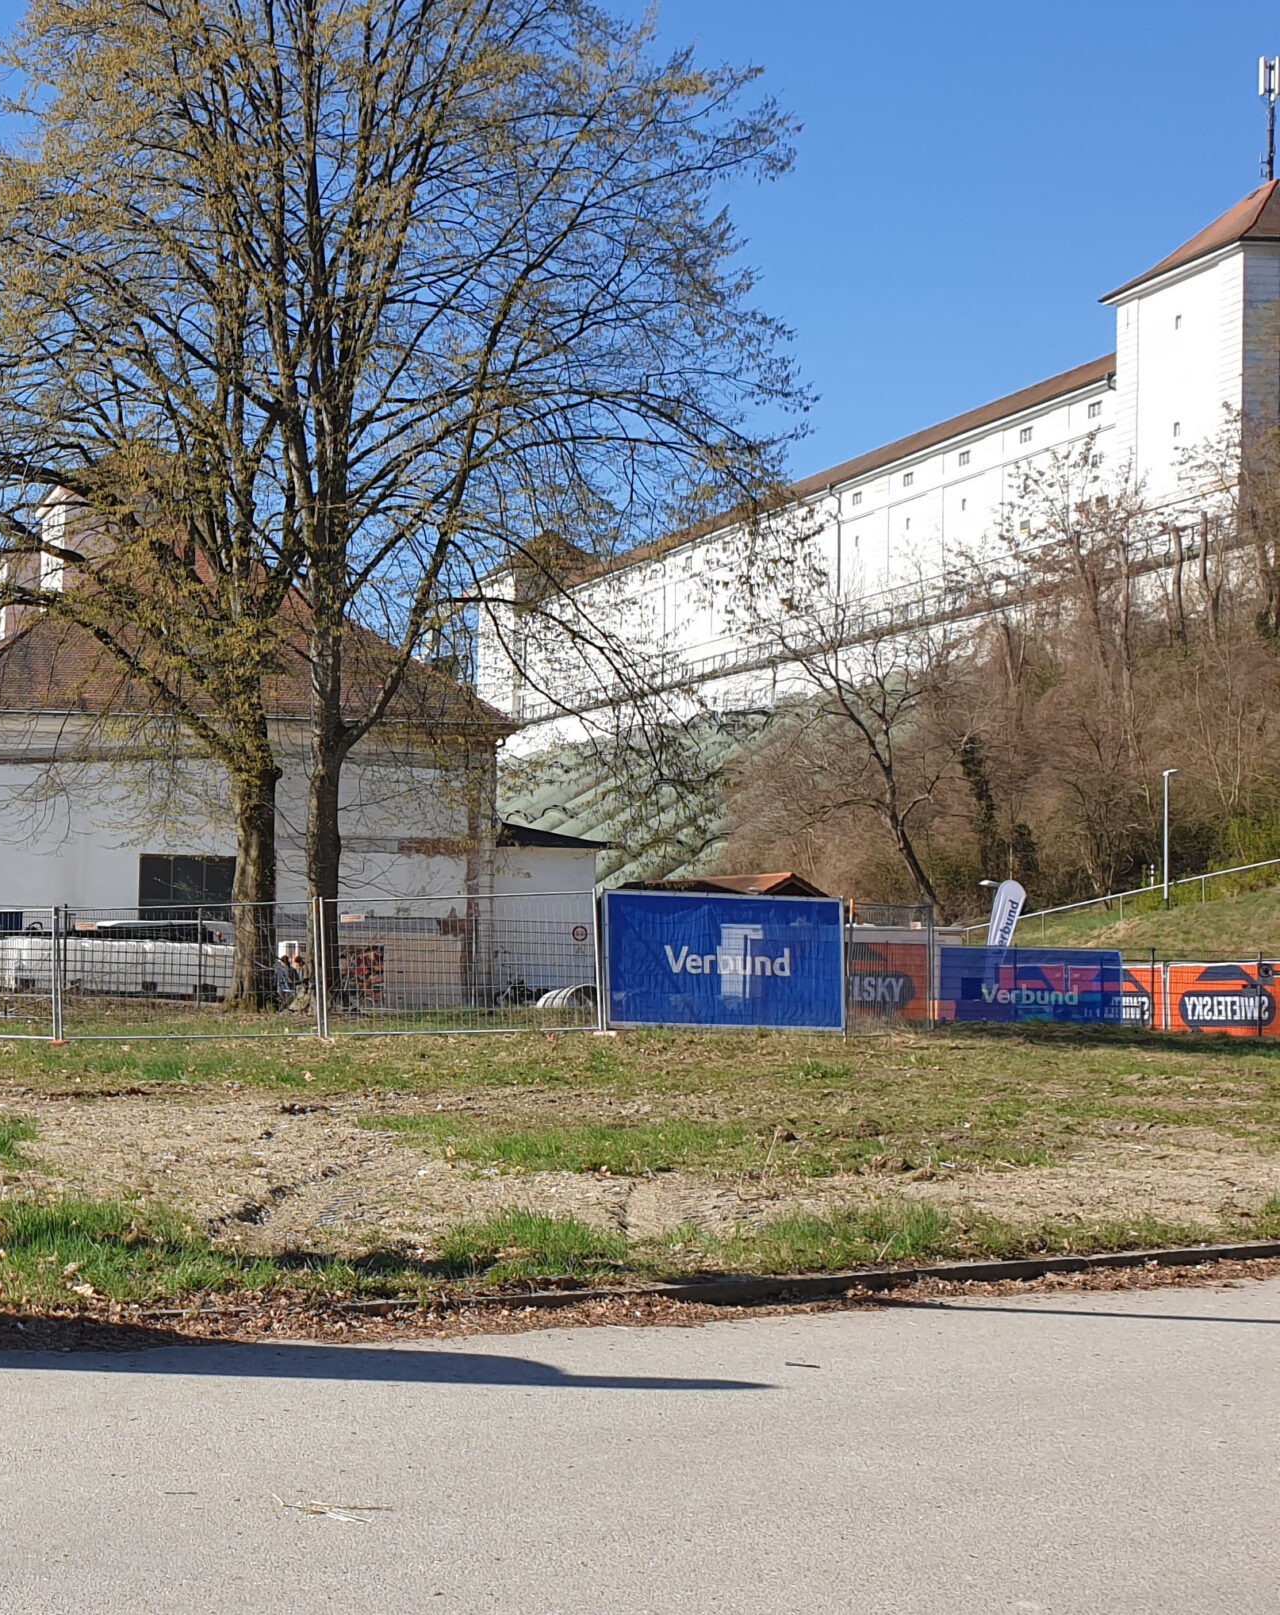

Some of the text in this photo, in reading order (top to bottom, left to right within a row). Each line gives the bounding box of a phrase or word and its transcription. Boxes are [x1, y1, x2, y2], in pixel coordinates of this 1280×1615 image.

[999, 899, 1019, 947] erbund
[664, 944, 791, 976] Verbund
[981, 983, 1079, 1006] Verbund
